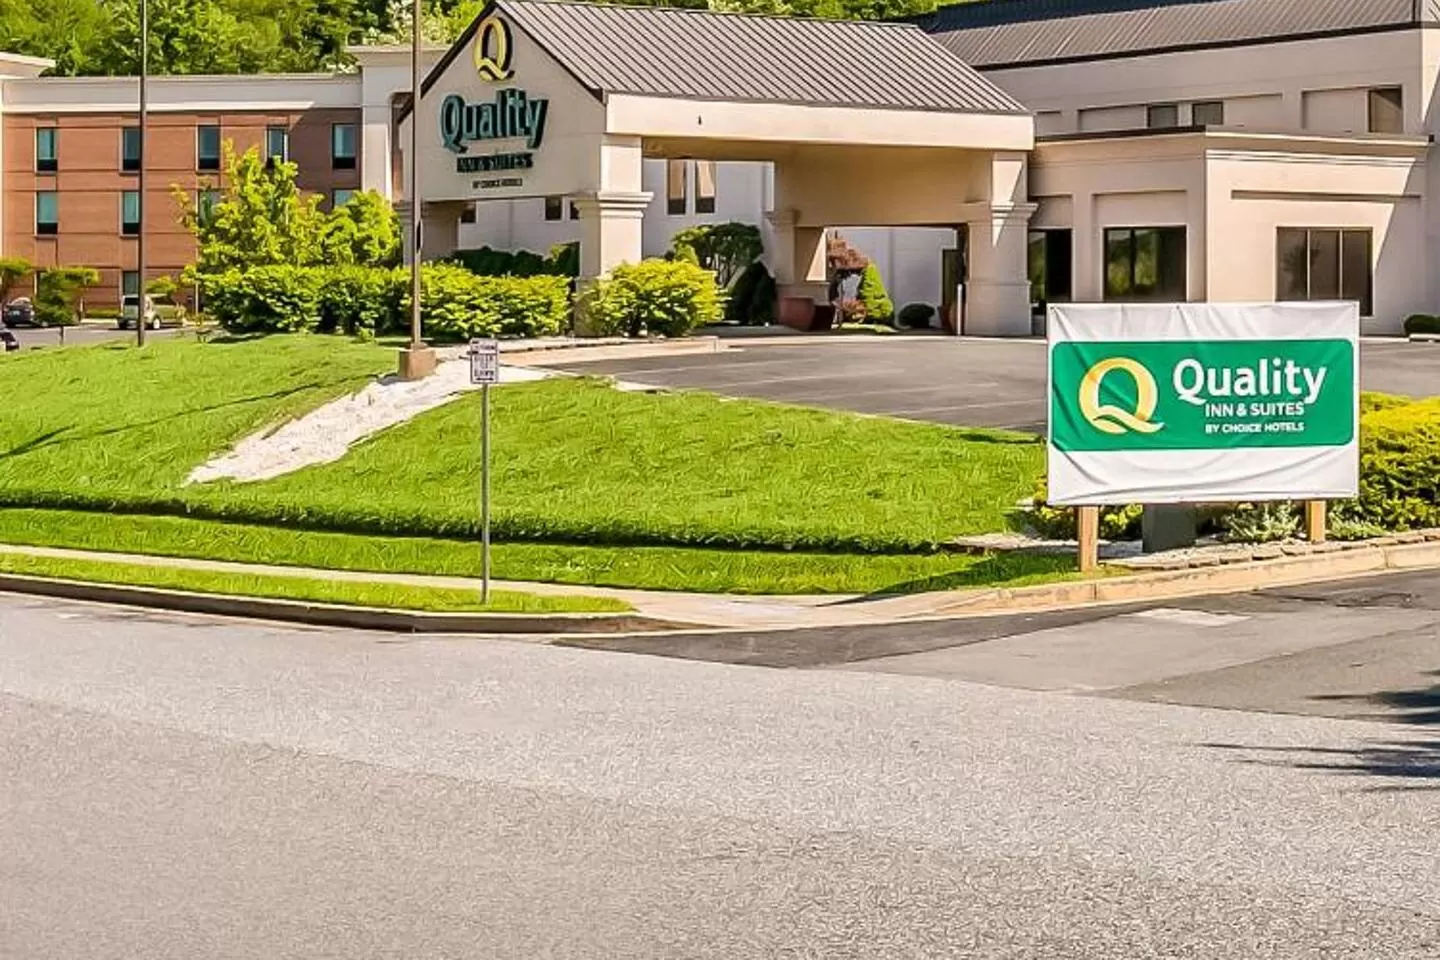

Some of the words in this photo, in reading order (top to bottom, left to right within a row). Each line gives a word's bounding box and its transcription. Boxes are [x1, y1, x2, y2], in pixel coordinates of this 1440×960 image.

[474, 17, 515, 80] Q
[441, 88, 549, 154] Quality
[1079, 356, 1165, 434] Q
[1173, 358, 1327, 405] Quality
[1205, 403, 1233, 417] INN
[1236, 402, 1247, 416] &
[1250, 401, 1304, 416] SUITES
[1205, 423, 1220, 434] BY
[1222, 422, 1262, 433] CHOICE
[1264, 421, 1305, 432] HOTELS
